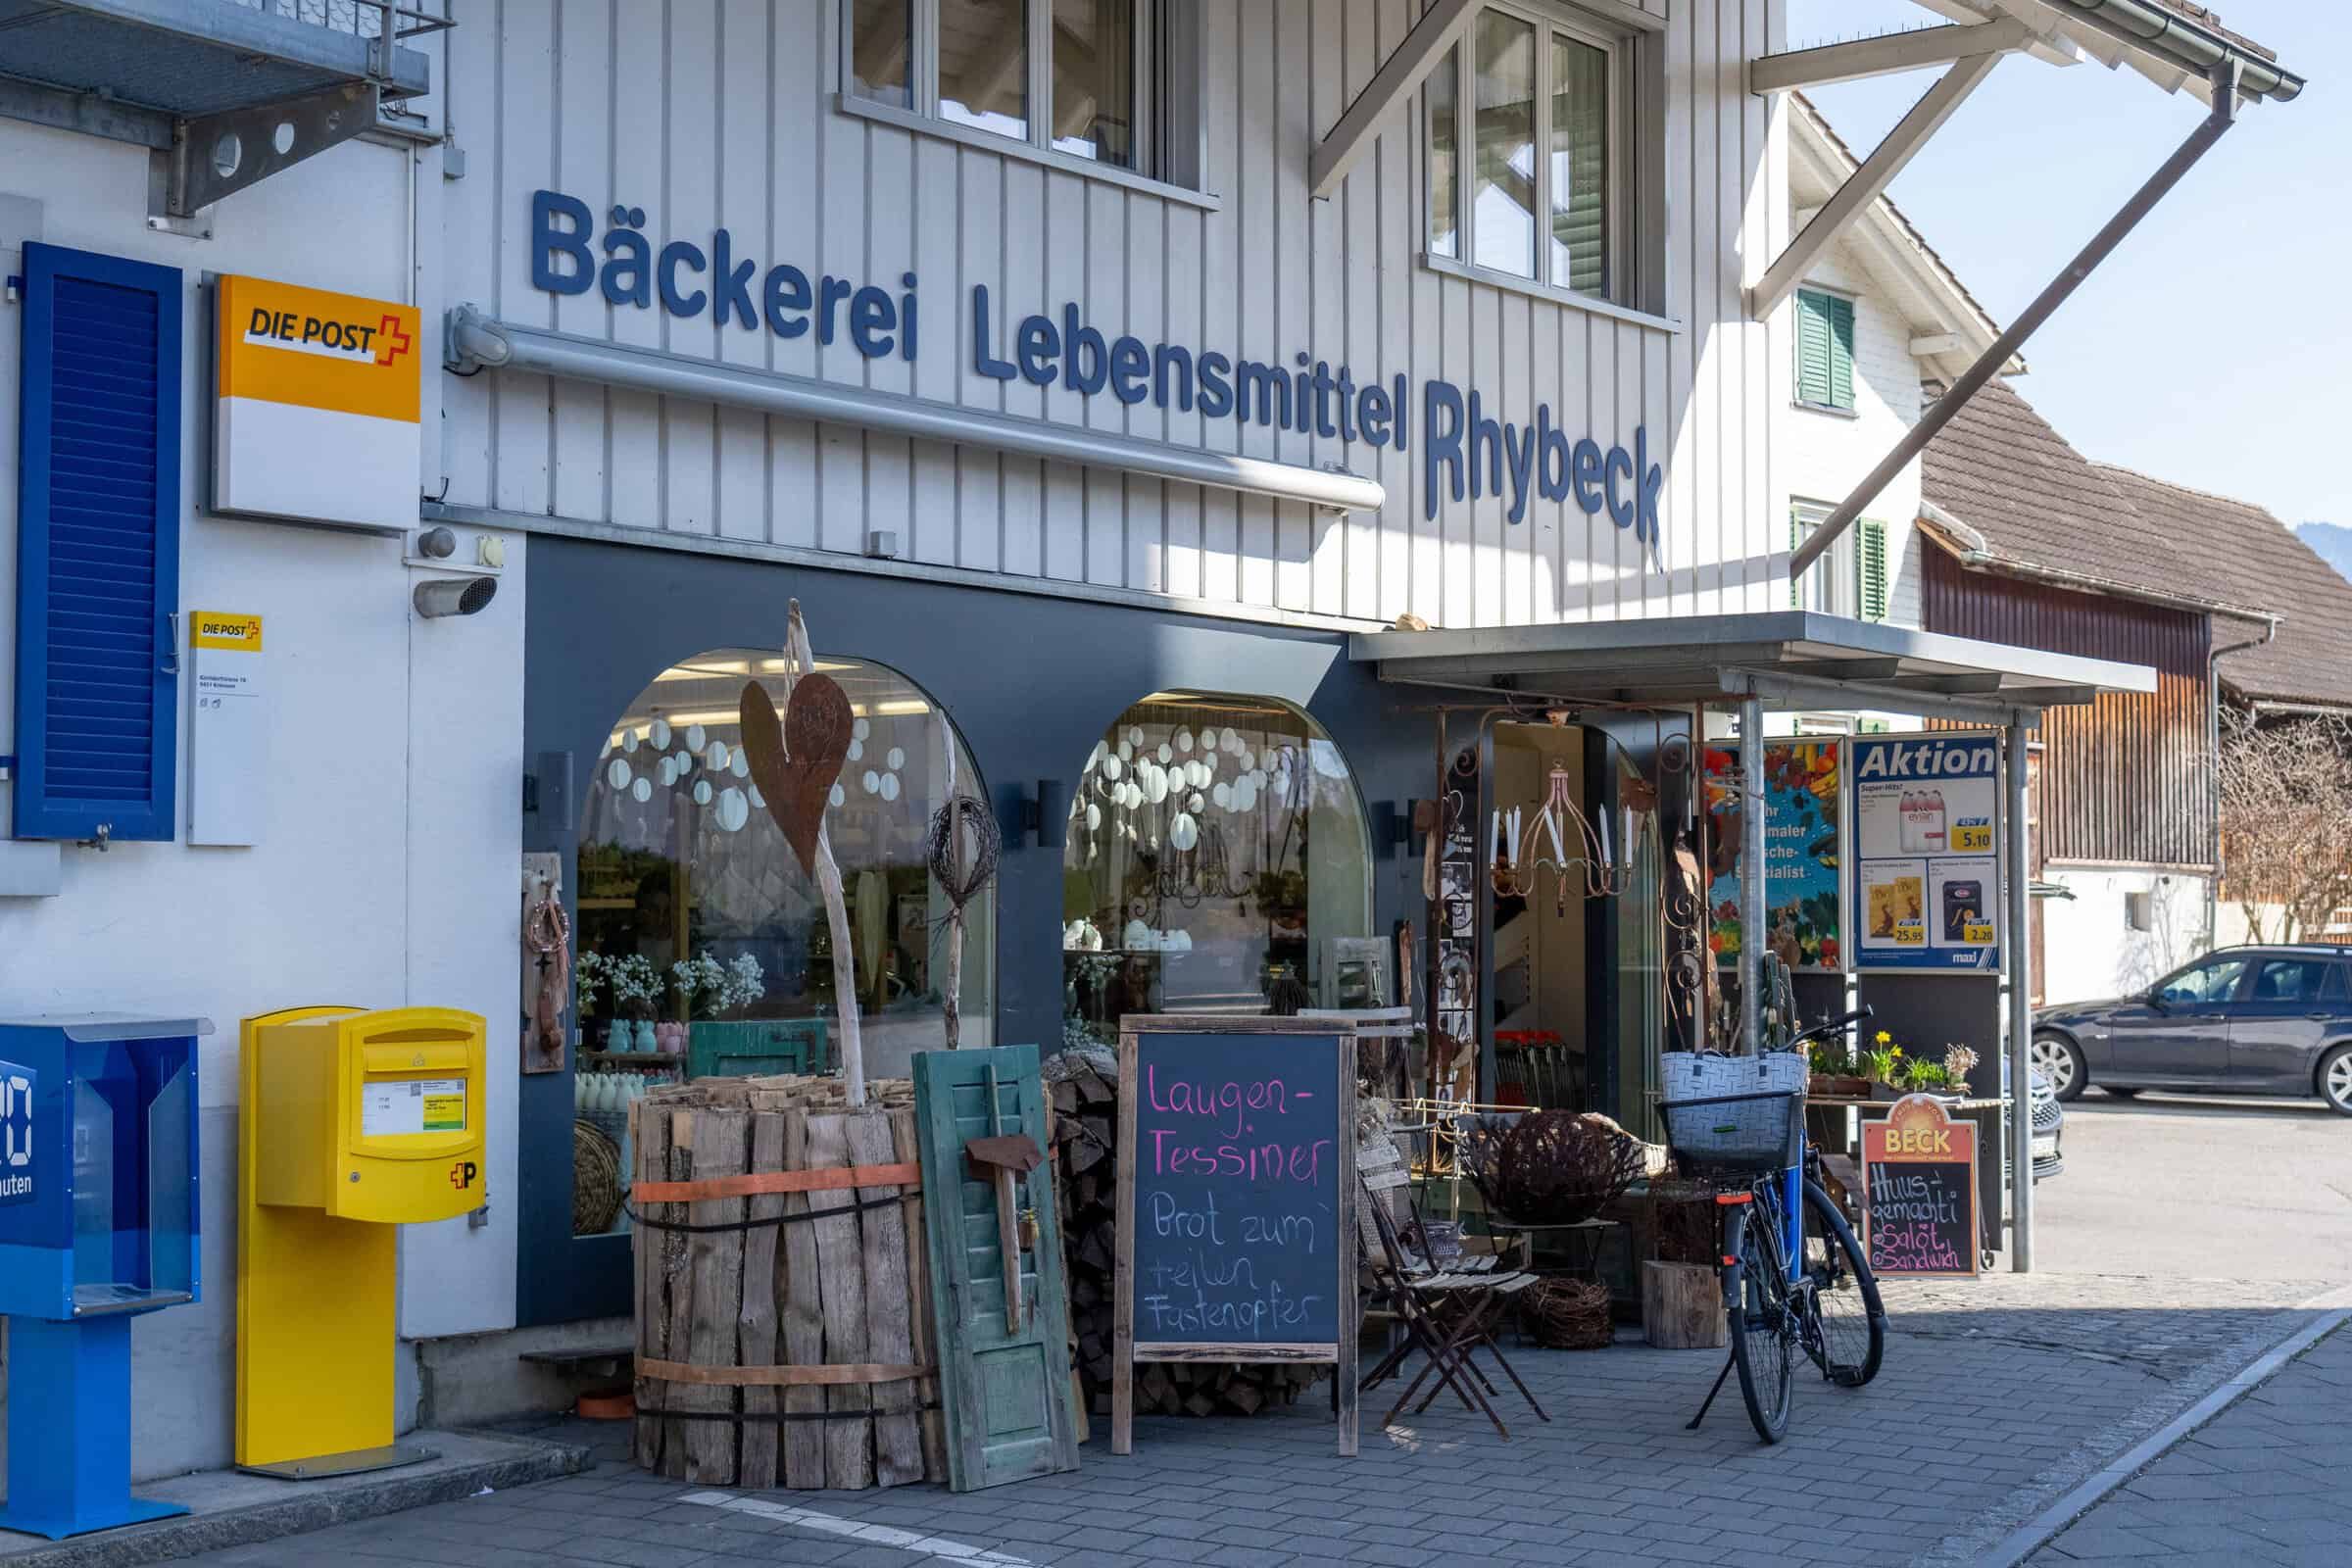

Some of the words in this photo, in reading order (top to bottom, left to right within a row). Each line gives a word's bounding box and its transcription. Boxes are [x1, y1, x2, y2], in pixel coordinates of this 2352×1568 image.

[249, 307, 298, 342] DIE
[302, 317, 377, 354] POST
[532, 189, 917, 362] Bäckerei
[974, 283, 1406, 452] Lebensmittel
[1426, 379, 1663, 574] Rhybeck
[202, 622, 220, 635] DIE
[220, 624, 246, 636] POST
[1858, 740, 1995, 777] Aktion
[1963, 832, 1990, 848] 5.10
[1896, 930, 1924, 942] 25.95
[1973, 930, 1993, 941] 2.20
[1147, 1063, 1315, 1140] Laugen-
[1148, 1124, 1332, 1187] Tessiner
[1885, 1129, 1952, 1153] BECK
[464, 1162, 477, 1189] P
[1147, 1191, 1225, 1247] Brot
[1240, 1213, 1315, 1254] zum
[1147, 1248, 1259, 1291] teilen
[1144, 1279, 1325, 1340] Fastenopfer
